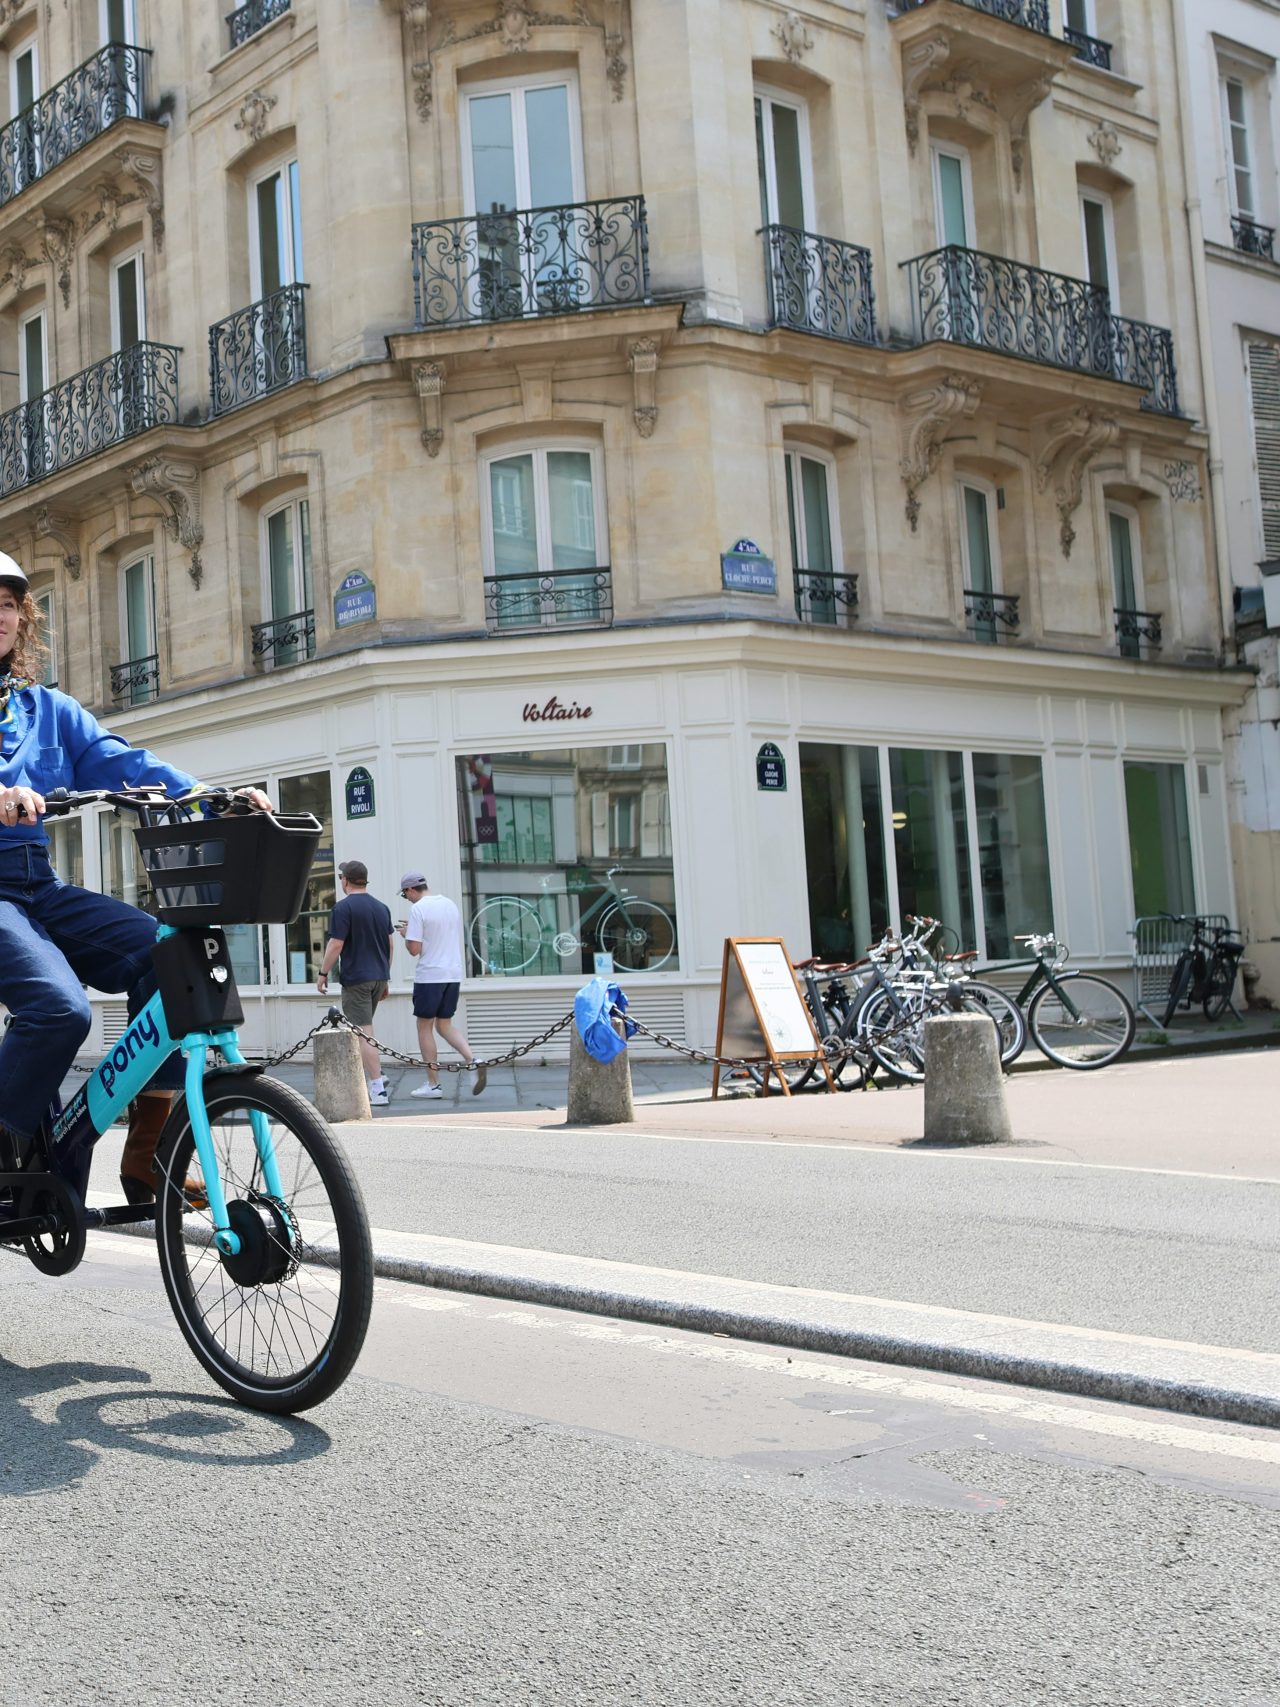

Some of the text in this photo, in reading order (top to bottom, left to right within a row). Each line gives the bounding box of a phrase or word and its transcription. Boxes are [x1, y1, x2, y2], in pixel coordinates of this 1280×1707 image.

[347, 597, 362, 608] RUE
[522, 696, 593, 722] Voltaire
[353, 786, 365, 796] RUE
[351, 802, 370, 814] RIVOLI
[203, 938, 220, 960] P
[98, 1009, 160, 1099] pony
